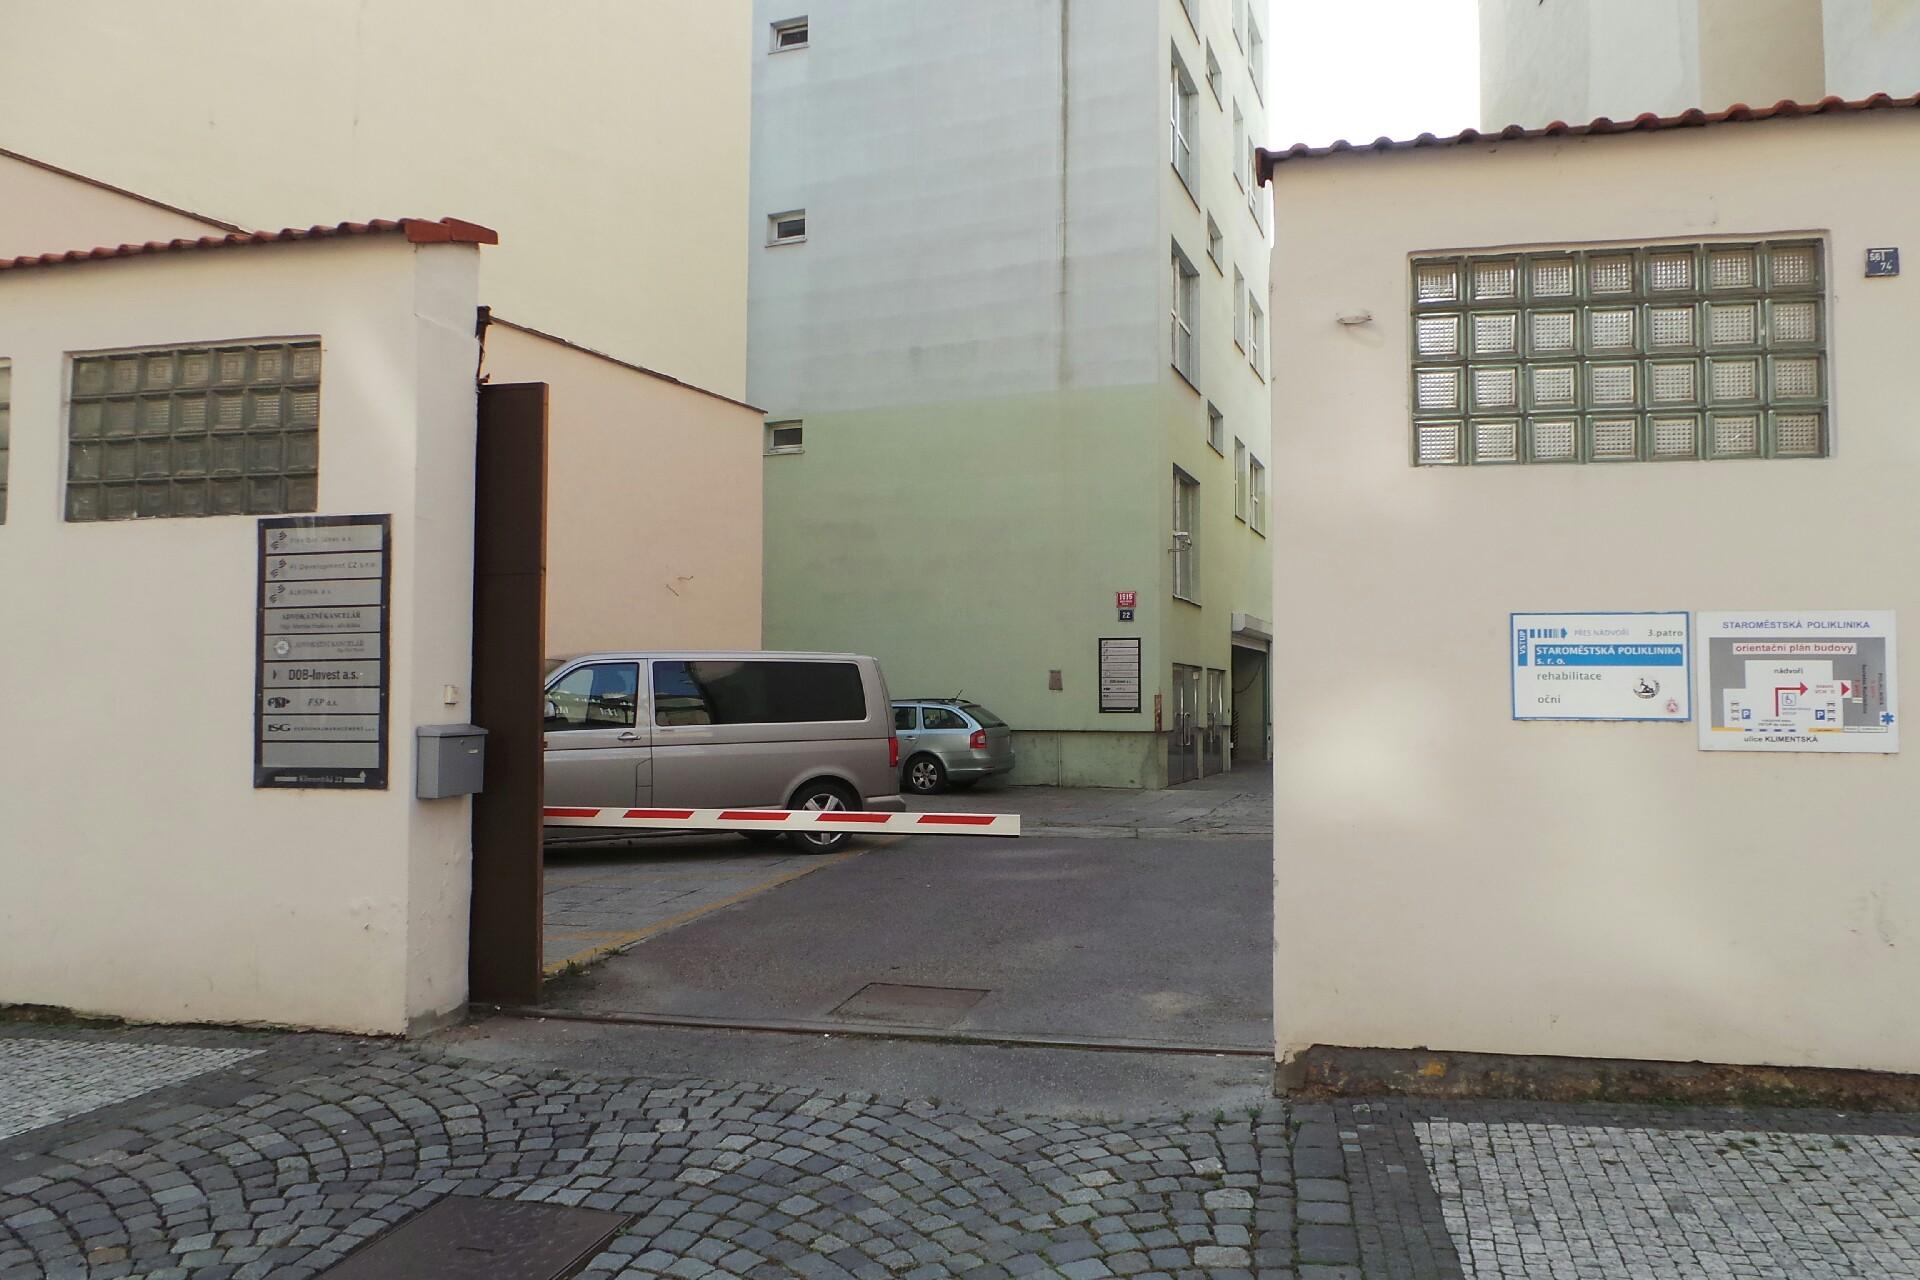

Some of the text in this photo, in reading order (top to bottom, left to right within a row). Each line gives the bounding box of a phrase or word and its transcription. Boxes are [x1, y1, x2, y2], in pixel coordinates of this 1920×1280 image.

[1722, 619, 1870, 629] STAROMĚSTSKÁ POLIKLINIKA
[1593, 628, 1630, 637] NÁDVOŘÍ
[1647, 629, 1684, 638] 3.patro
[1518, 630, 1527, 655] VSTUP
[1535, 645, 1682, 655] STAROMĚSTSKÁ POLIKLINIKA
[1735, 643, 1854, 653] orientační plán budovy
[288, 668, 359, 681] DOB-Invest a.s.
[1536, 671, 1602, 681] rehabilitace
[1537, 694, 1561, 704] oční
[1765, 735, 1818, 743] KLIMENTSKÁ
